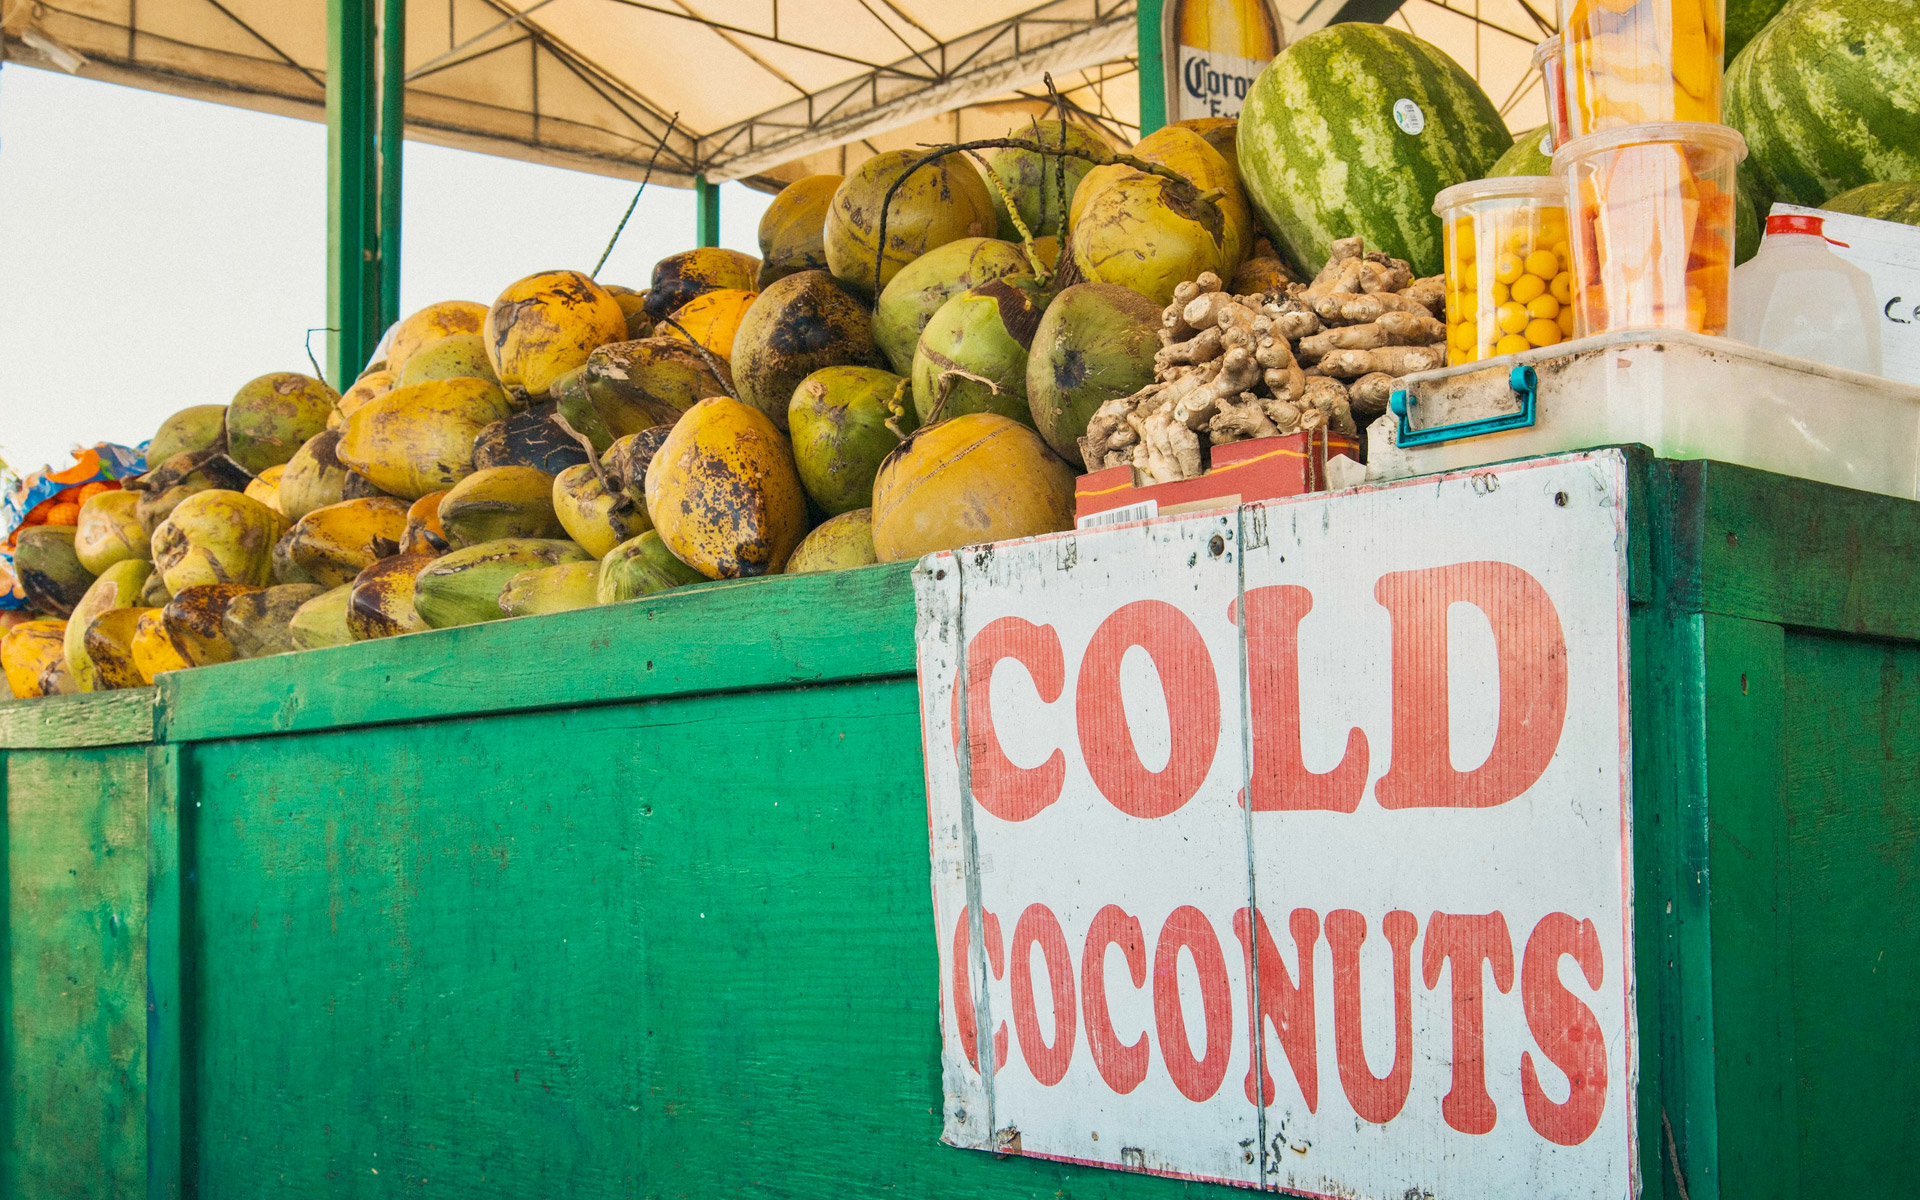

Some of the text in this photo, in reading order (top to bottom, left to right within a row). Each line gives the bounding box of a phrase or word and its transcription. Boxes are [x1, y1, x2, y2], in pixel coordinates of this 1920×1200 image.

[1185, 56, 1255, 104] Coro
[951, 561, 1568, 822] COLD
[953, 903, 1607, 1146] COCONUTS
